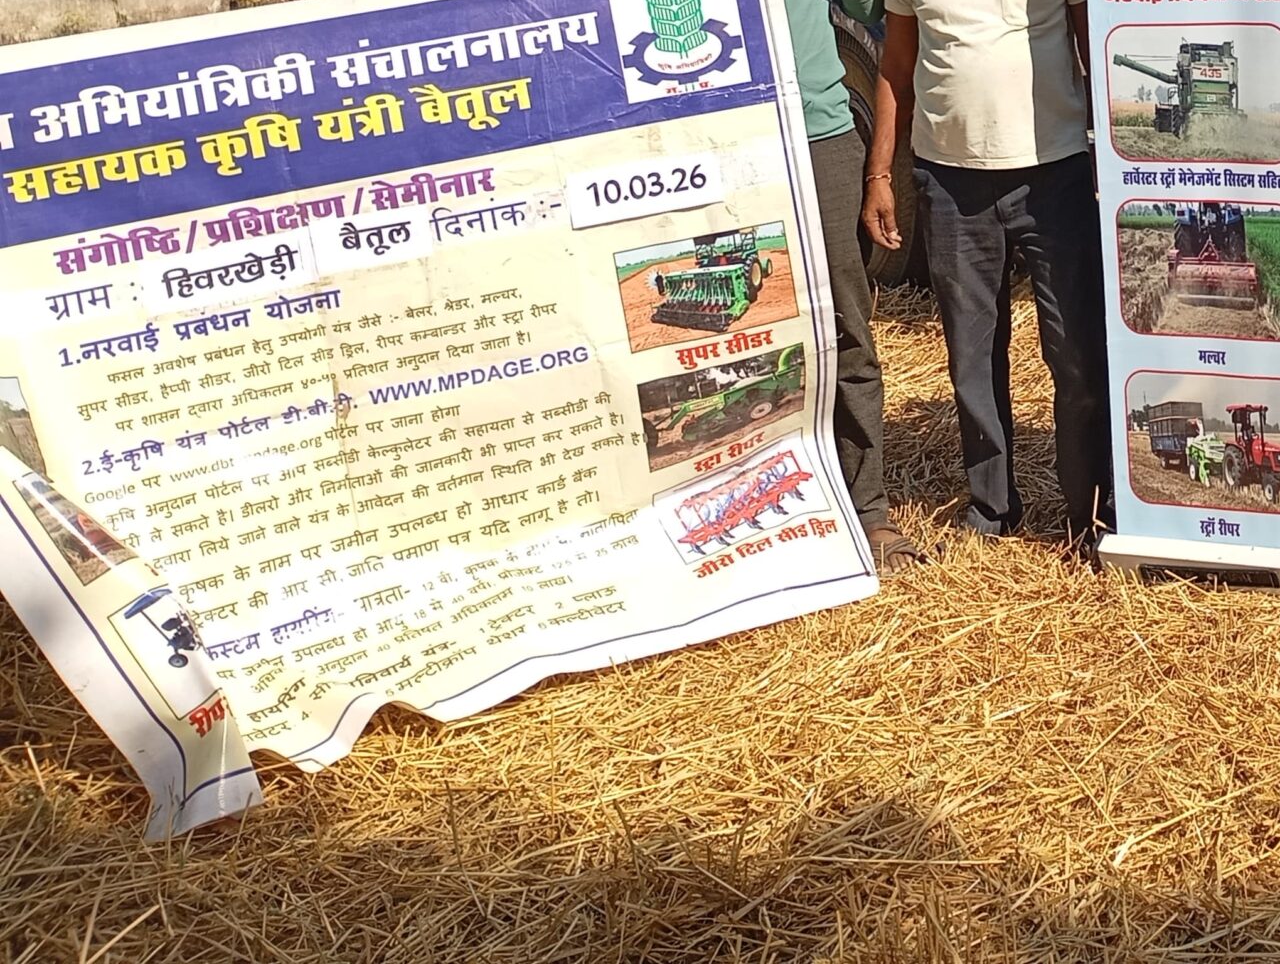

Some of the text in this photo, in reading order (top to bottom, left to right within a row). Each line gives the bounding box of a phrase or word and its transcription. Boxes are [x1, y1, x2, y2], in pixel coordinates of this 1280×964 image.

[30, 53, 315, 143] अभियांत्रिकी
[326, 12, 599, 108] संचालनालय
[3, 78, 532, 203] सहायक कृषि यंत्री बैतूल
[45, 284, 113, 321] ग्राम
[161, 244, 298, 298] हिवरखेड़ी
[339, 220, 411, 256] बैतूल
[429, 197, 527, 241] दिनांक
[586, 164, 707, 208] 10.03.26
[78, 303, 558, 421] सुपर जीरो टिल सीड रीपर और रीपर
[107, 313, 381, 383] फसल अवशेष प्रबंधन हेतु उपयोगी यंत्र जैसे
[173, 312, 251, 341] प्रबंधन
[265, 289, 341, 320] योजना
[675, 329, 774, 370] सुपर सीडर
[1198, 350, 1226, 365] मल्चर
[115, 418, 133, 432] पर
[141, 408, 180, 427] शासन
[232, 382, 293, 407] अधिकतम
[343, 360, 389, 381] प्रतिशत
[396, 350, 440, 371] अनुदान
[446, 343, 474, 359] दिया
[480, 336, 510, 351] जाता
[176, 430, 207, 450] यंत्र
[218, 415, 271, 440] पोर्टल
[369, 346, 589, 405] WWW.MPDAGE.ORG
[84, 405, 461, 504] Google पर पोर्टल पर जाना होगा
[145, 492, 197, 518] अनुदान
[204, 478, 243, 499] पोर्टल
[438, 428, 456, 443] की
[463, 418, 515, 438] सहायता
[594, 391, 612, 405] की
[171, 416, 603, 537] सकते और की जानकारी भी प्राप्त कर सकते
[199, 434, 624, 557] लिये जाने वाले यंत्र के आवेदन की वर्तमान भी देख सकते
[178, 466, 597, 603] कृषक के नाम पर जमीन उपलब्ध हो आधार कार्ड बैंक
[248, 507, 554, 609] की यदि लागू
[693, 517, 839, 579] जीरो टिल सीड ड्रिल
[1218, 518, 1240, 536] रीपर
